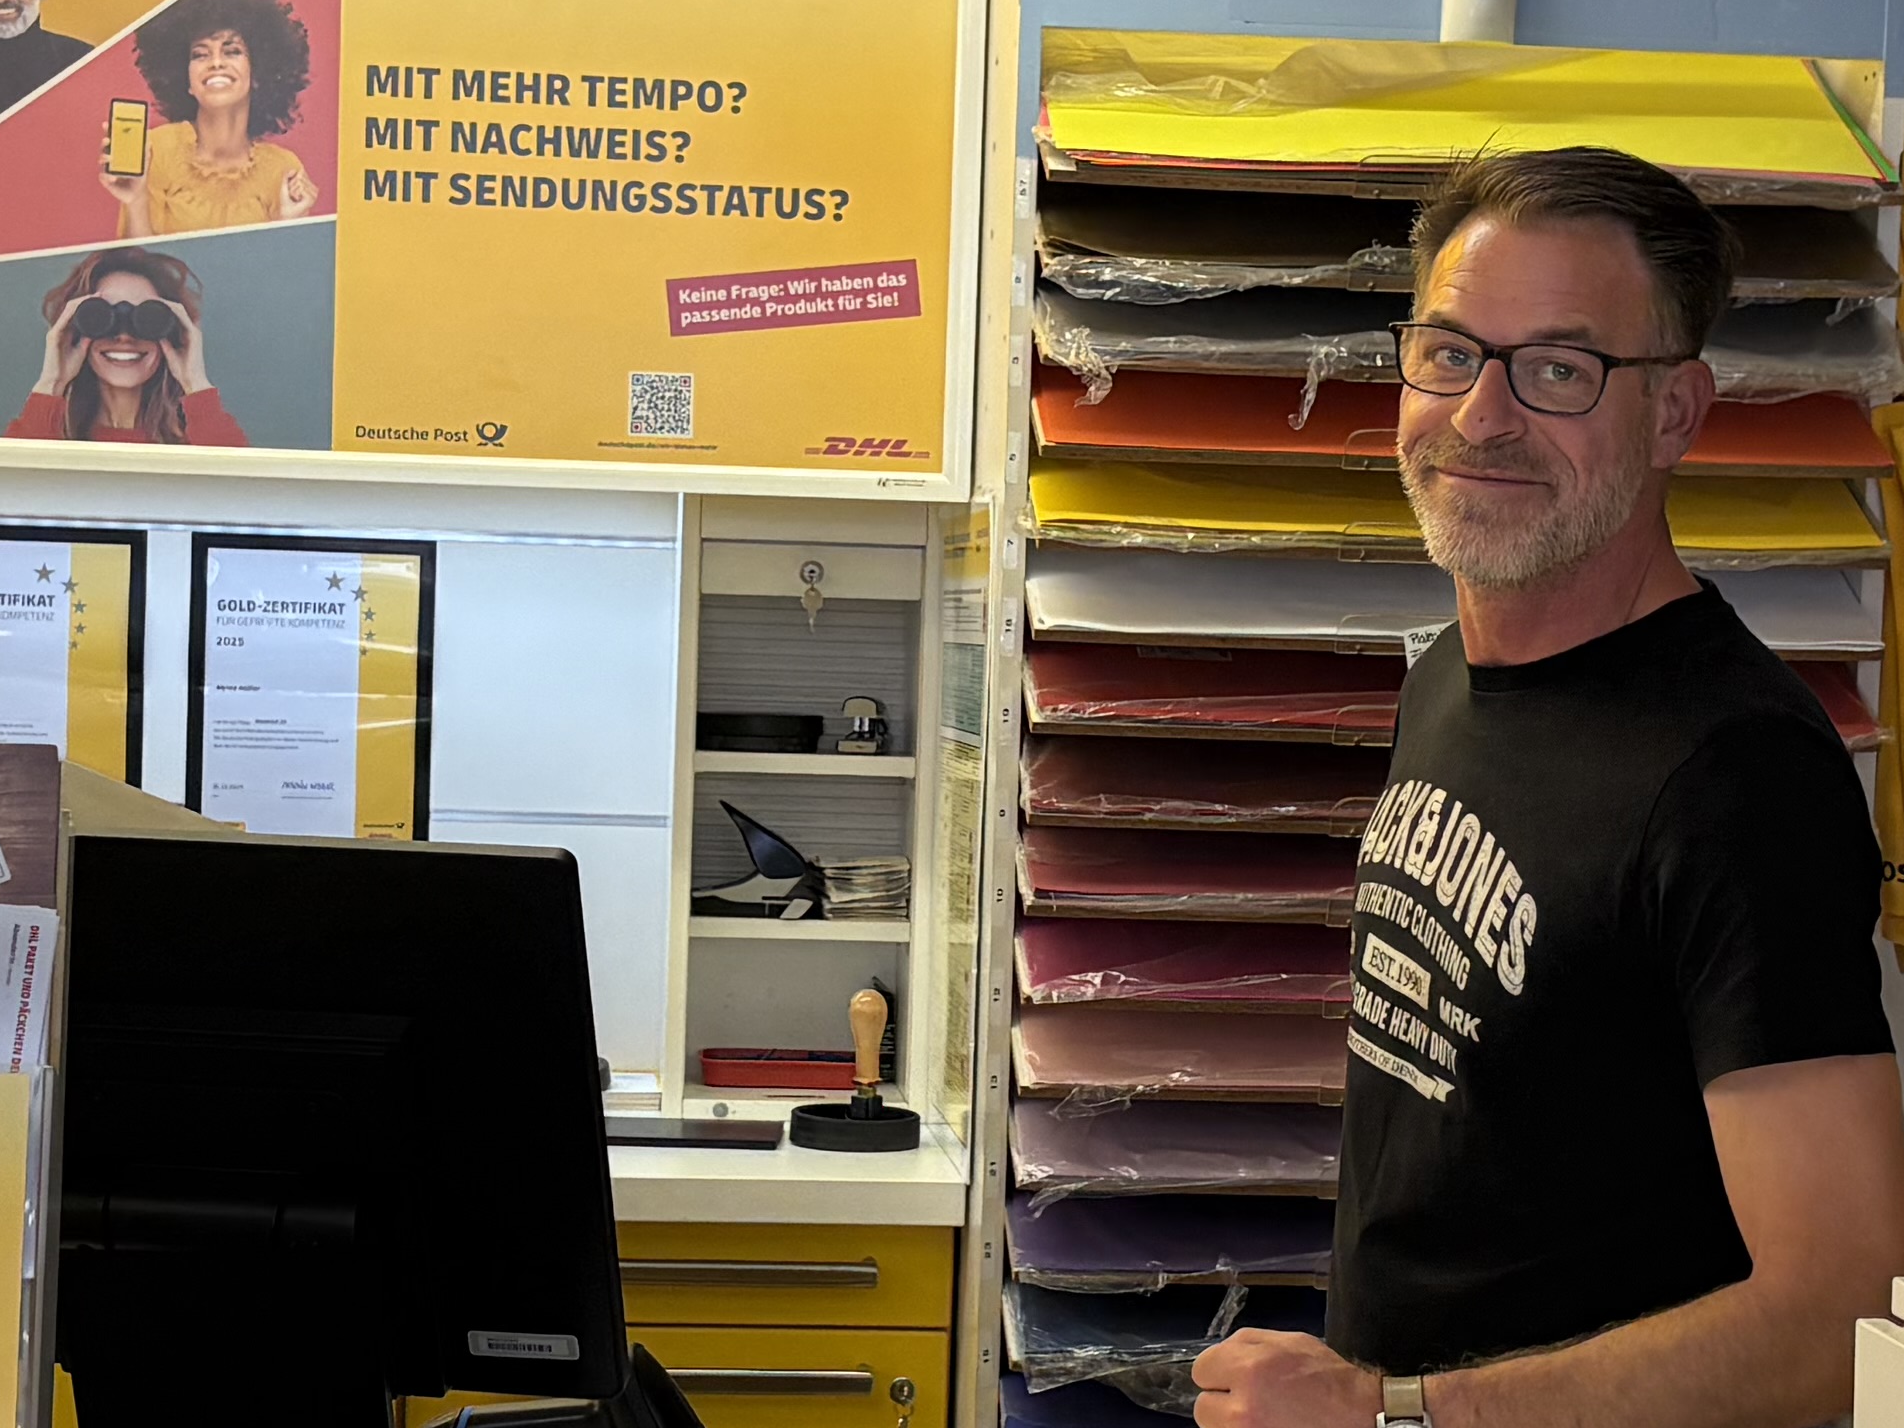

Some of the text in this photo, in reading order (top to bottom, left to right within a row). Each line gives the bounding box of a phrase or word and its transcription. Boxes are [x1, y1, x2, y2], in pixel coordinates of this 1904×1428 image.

[366, 65, 748, 114] MIT MEHR TEMPO?
[364, 117, 691, 163] MIT NACHWEIS?
[363, 169, 850, 222] MIT SENDUNGSSTATUS?
[679, 272, 907, 304] Keine Frage: Wir haben das
[680, 291, 899, 327] passende Produkt für Sie!
[355, 425, 914, 459] Deutsche Post DHL
[217, 599, 347, 616] GOLD-ZERTIFIKAT
[1357, 780, 1537, 996] ACK&JONES
[1411, 905, 1471, 990] CLOTHING
